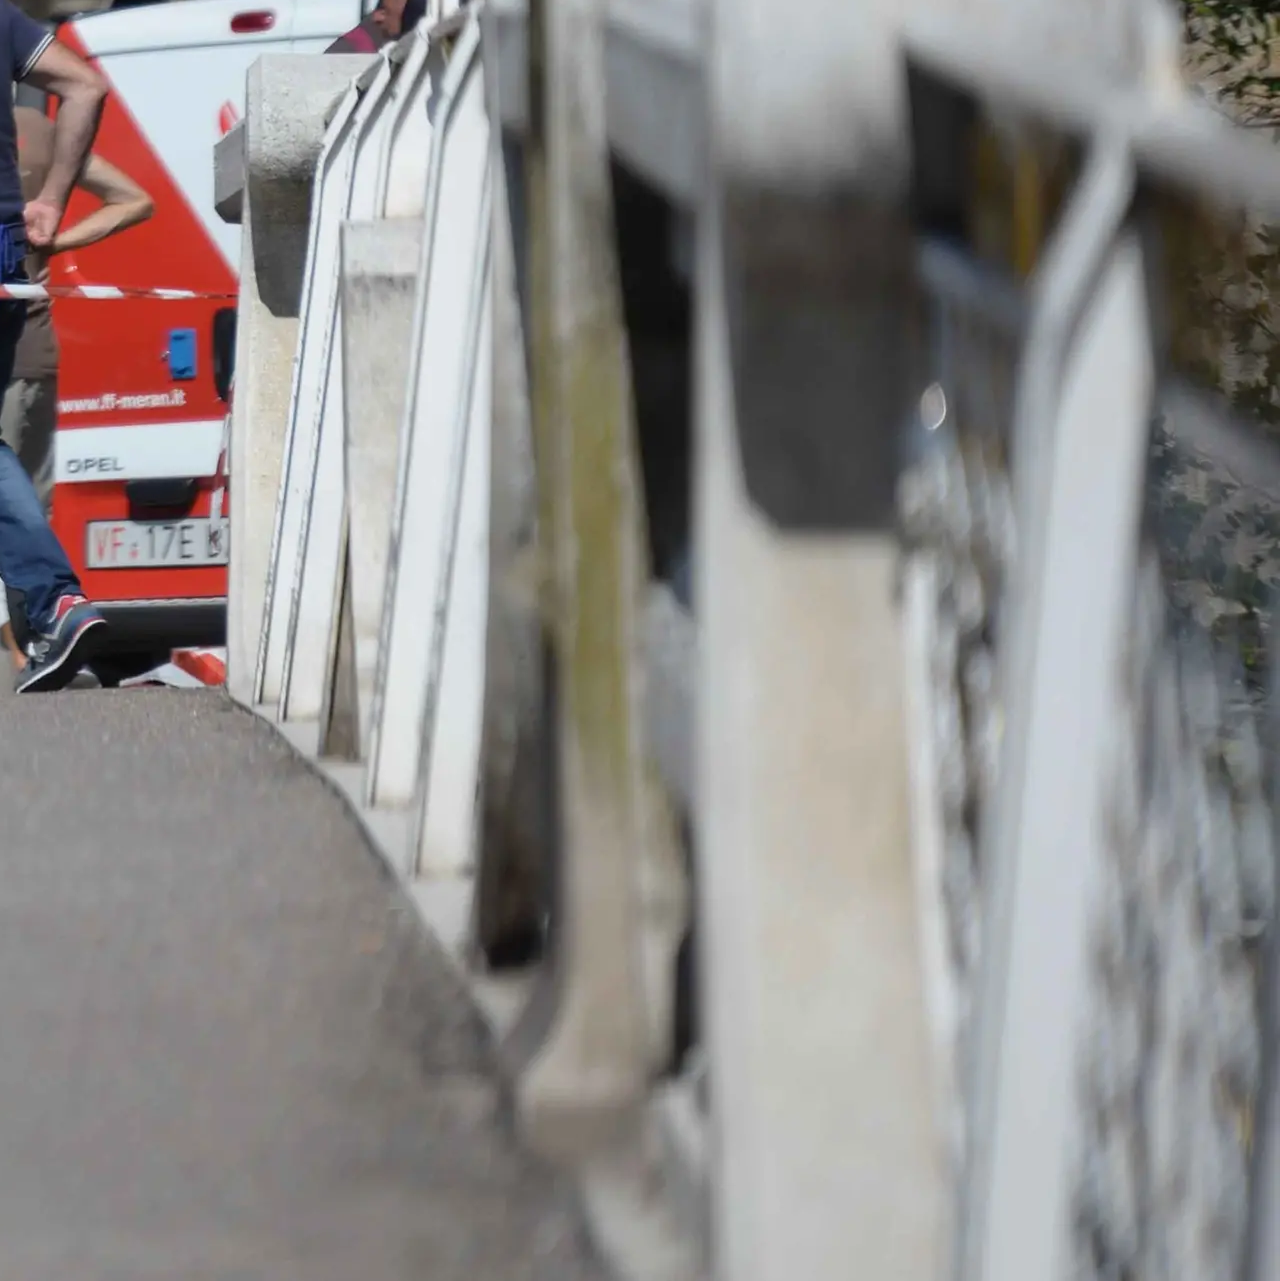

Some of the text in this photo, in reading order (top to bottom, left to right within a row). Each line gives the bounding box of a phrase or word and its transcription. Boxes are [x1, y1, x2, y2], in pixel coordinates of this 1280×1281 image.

[66, 456, 125, 474] OPEL
[93, 526, 127, 561] VF
[146, 523, 194, 560] 17E
